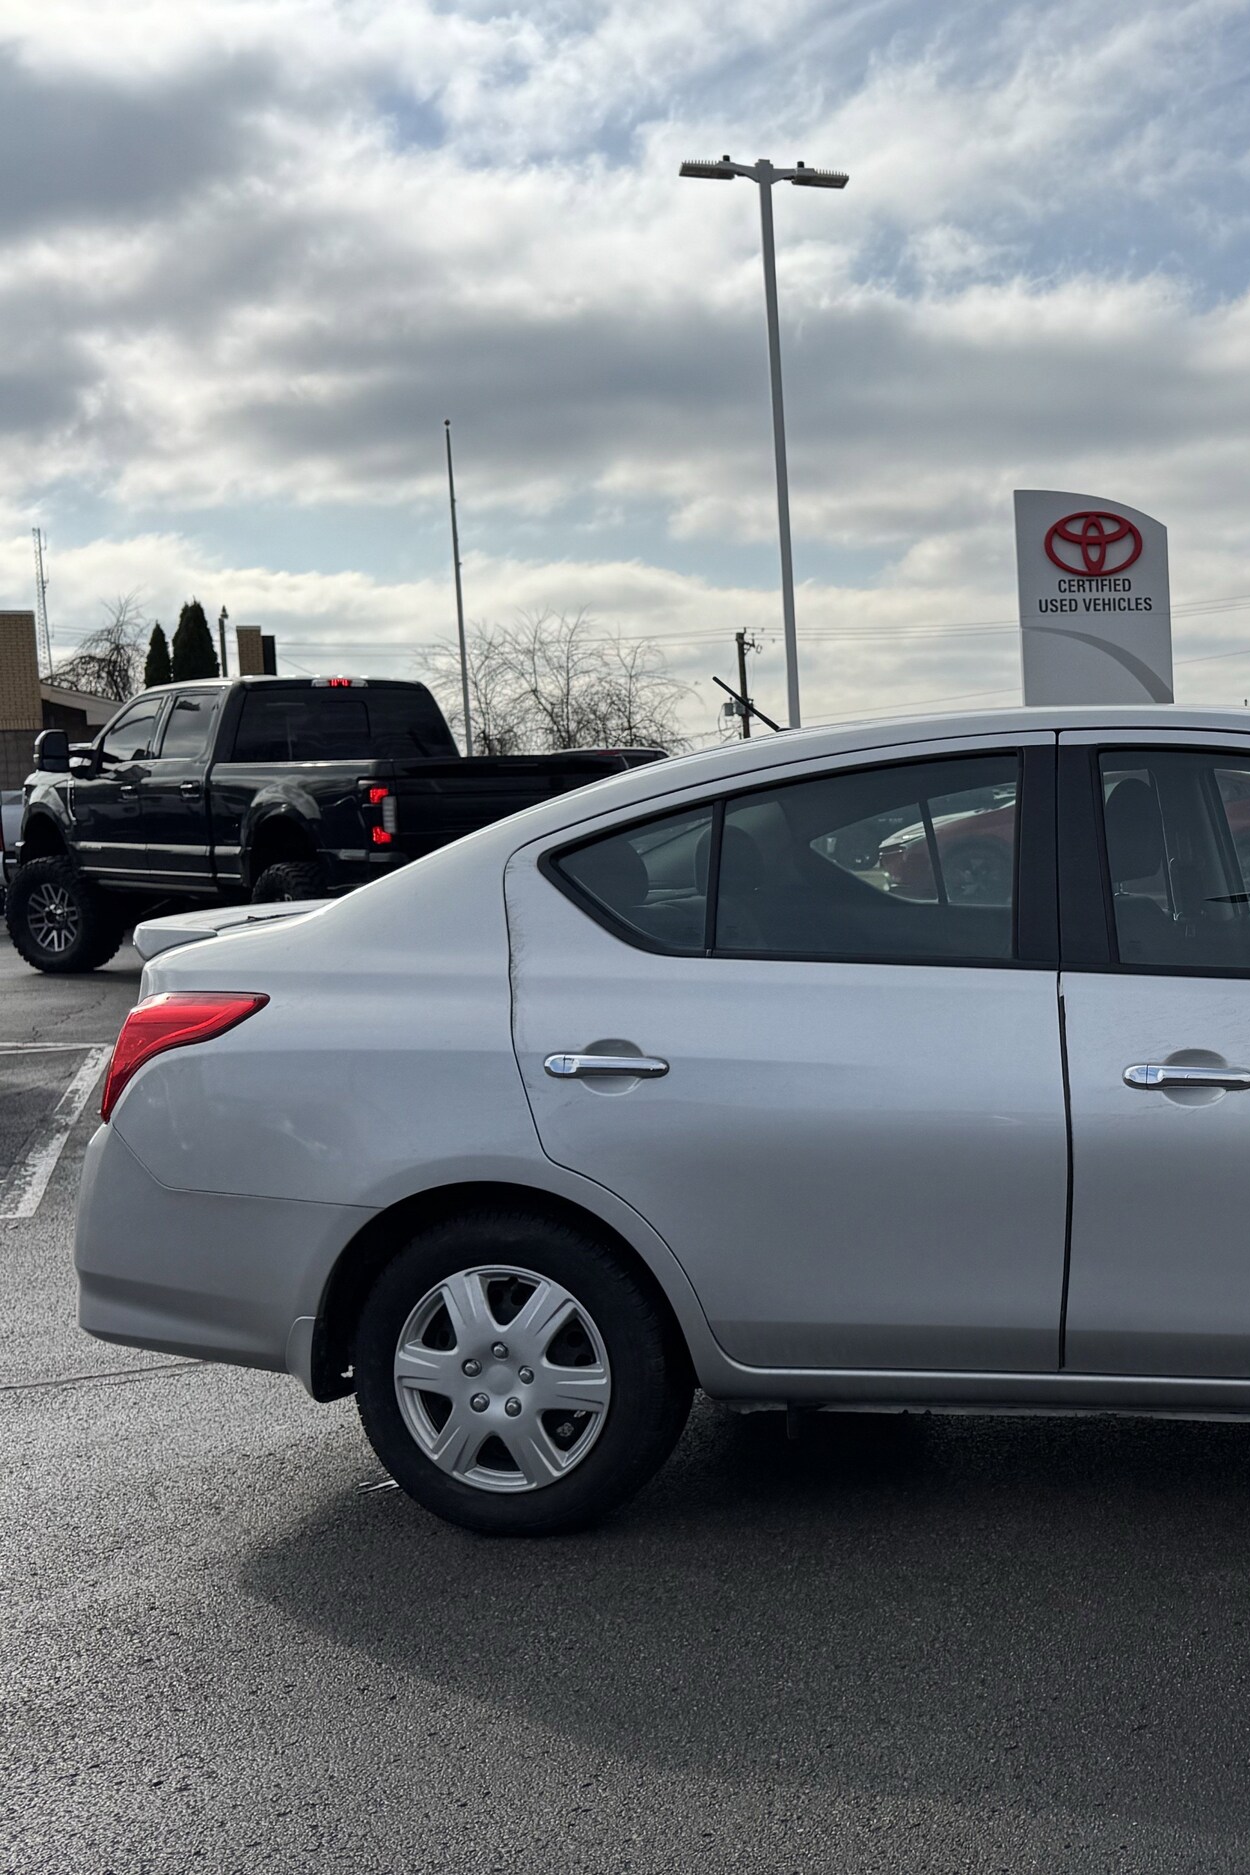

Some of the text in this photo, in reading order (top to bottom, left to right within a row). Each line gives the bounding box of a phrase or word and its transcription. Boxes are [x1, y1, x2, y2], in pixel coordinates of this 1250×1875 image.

[1058, 578, 1132, 593] CERTIFIED
[1039, 597, 1153, 613] USED VEHICLES
